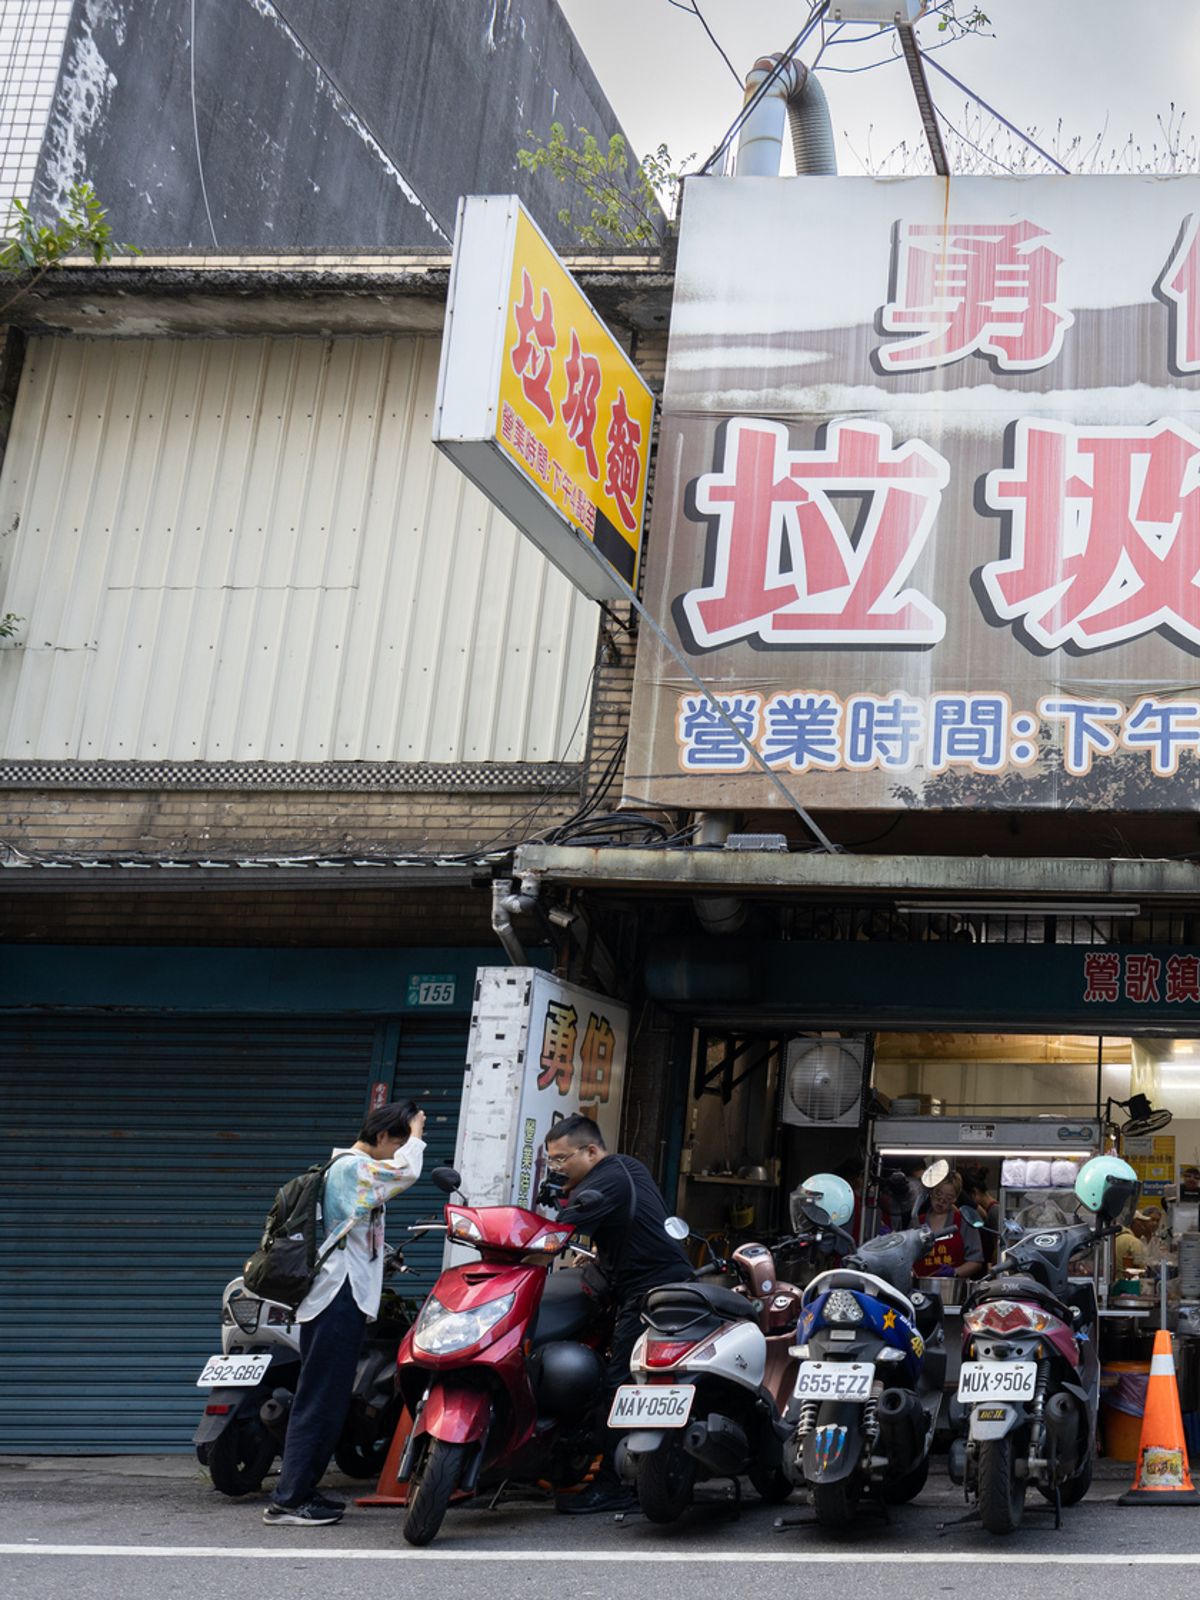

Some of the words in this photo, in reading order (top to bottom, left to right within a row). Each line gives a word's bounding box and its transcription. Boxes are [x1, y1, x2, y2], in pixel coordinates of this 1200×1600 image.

[512, 267, 642, 532] 垃圾麵
[423, 985, 453, 1002] 155
[537, 1000, 616, 1104] 勇伯
